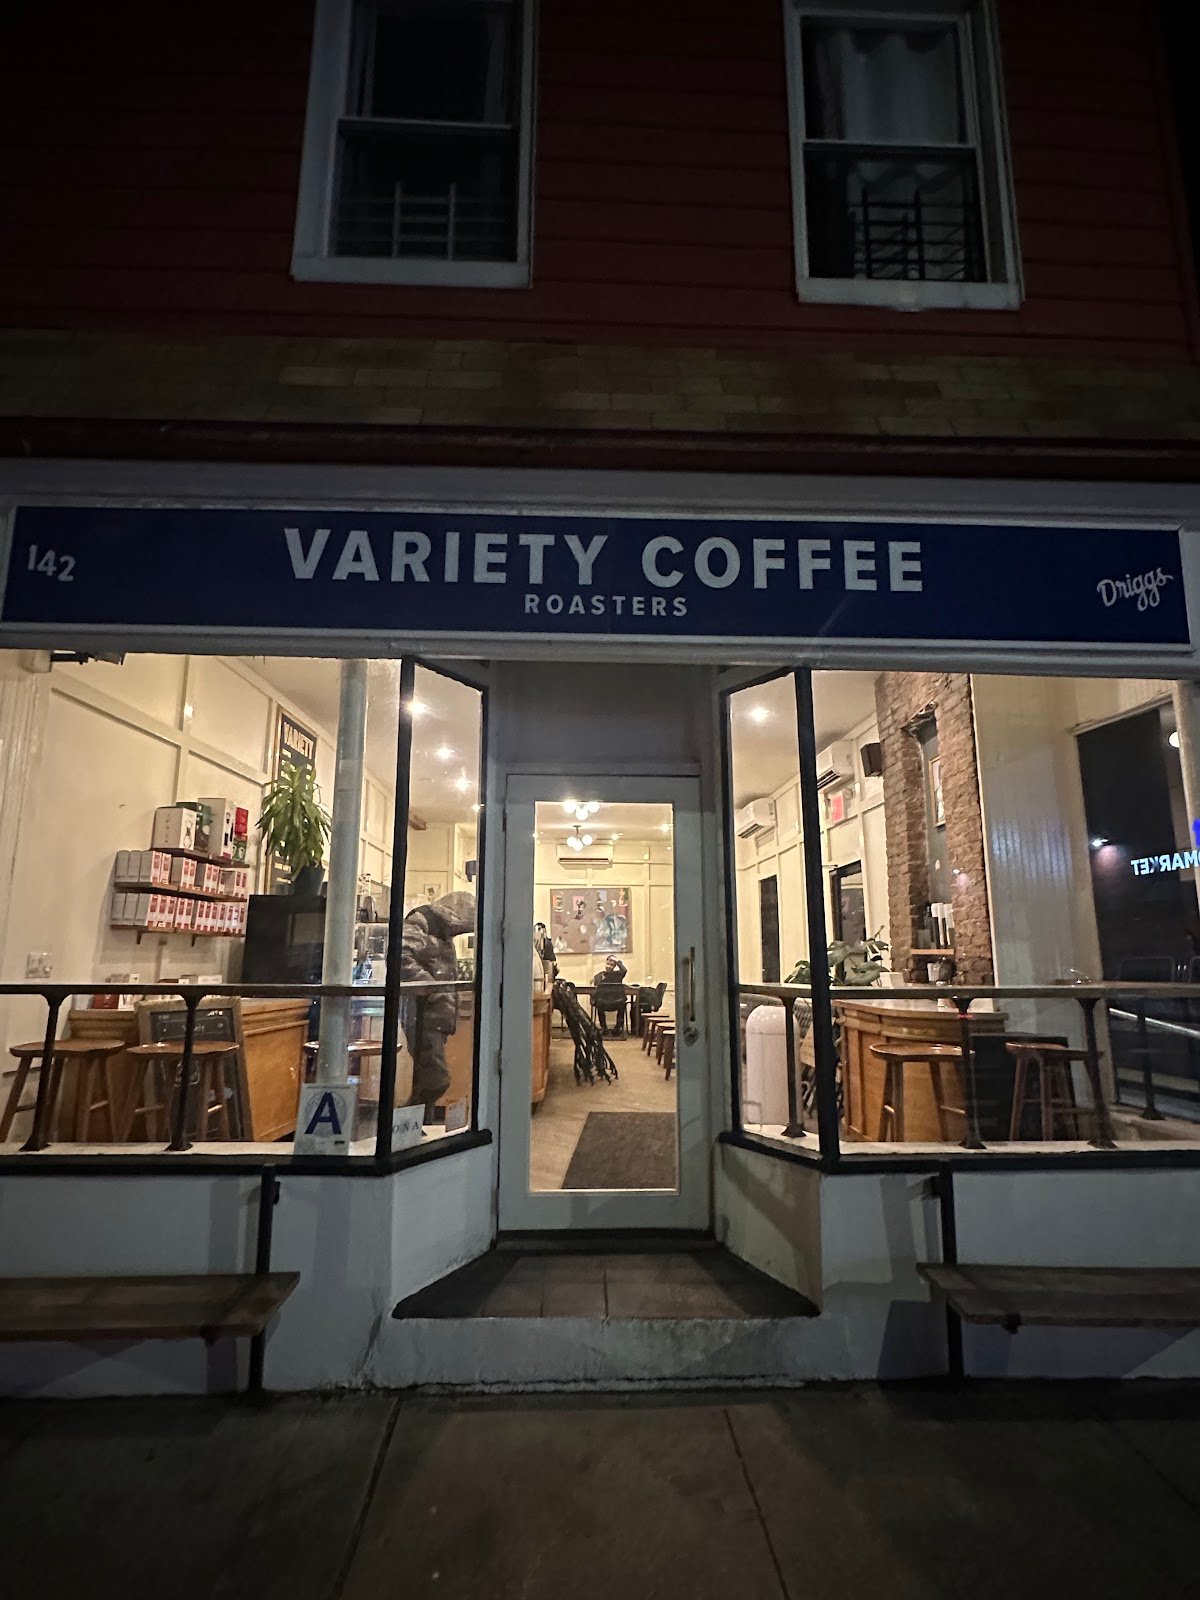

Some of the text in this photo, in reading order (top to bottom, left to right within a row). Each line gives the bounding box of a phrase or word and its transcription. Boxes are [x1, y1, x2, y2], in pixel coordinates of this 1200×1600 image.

[27, 544, 76, 583] 142
[283, 527, 924, 592] VARIETY COFFEE
[524, 594, 688, 617] ROASTERS
[1096, 566, 1173, 612] Driggs
[304, 1091, 342, 1135] A
